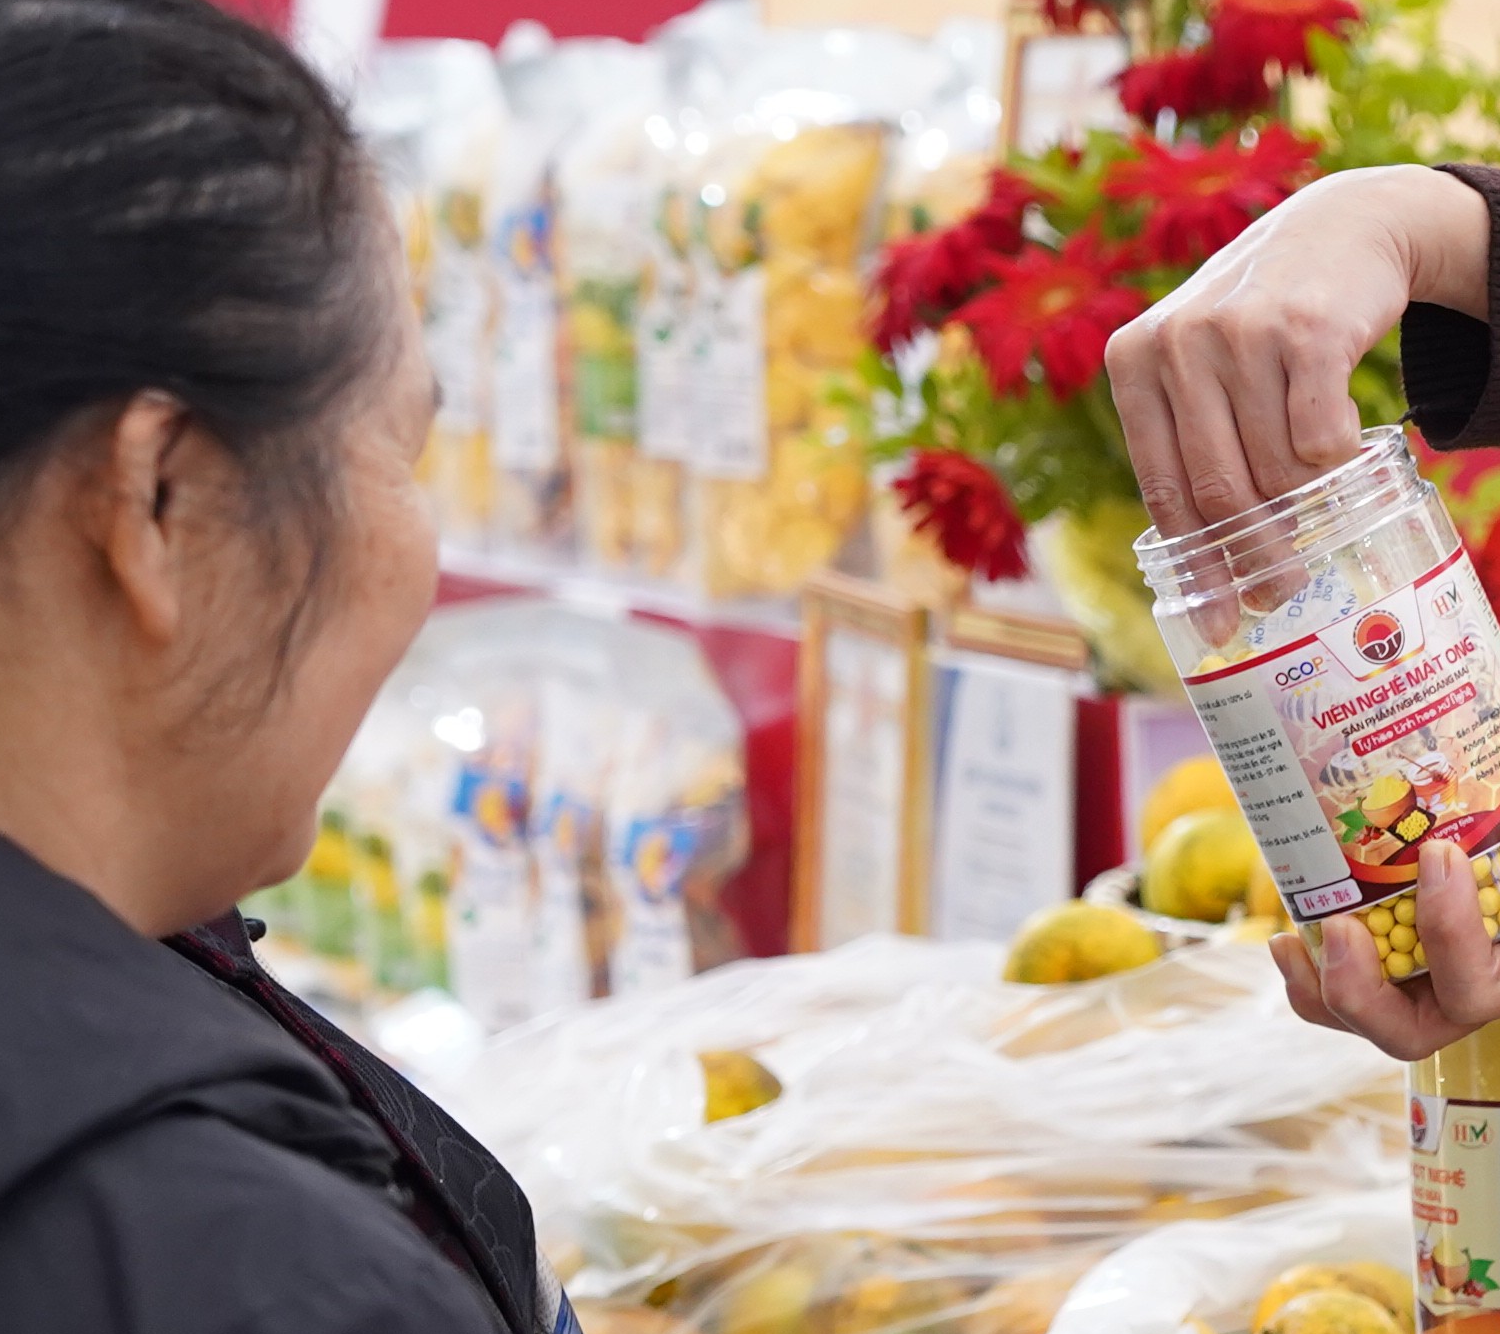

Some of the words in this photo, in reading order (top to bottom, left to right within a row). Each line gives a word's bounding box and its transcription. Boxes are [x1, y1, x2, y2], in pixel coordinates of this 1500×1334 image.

[1275, 655, 1324, 687] OCOP
[1312, 699, 1358, 730] VIÊN
[1357, 676, 1407, 712] NGHỆ
[1407, 656, 1443, 688] MẬT
[1443, 635, 1475, 665] ONG
